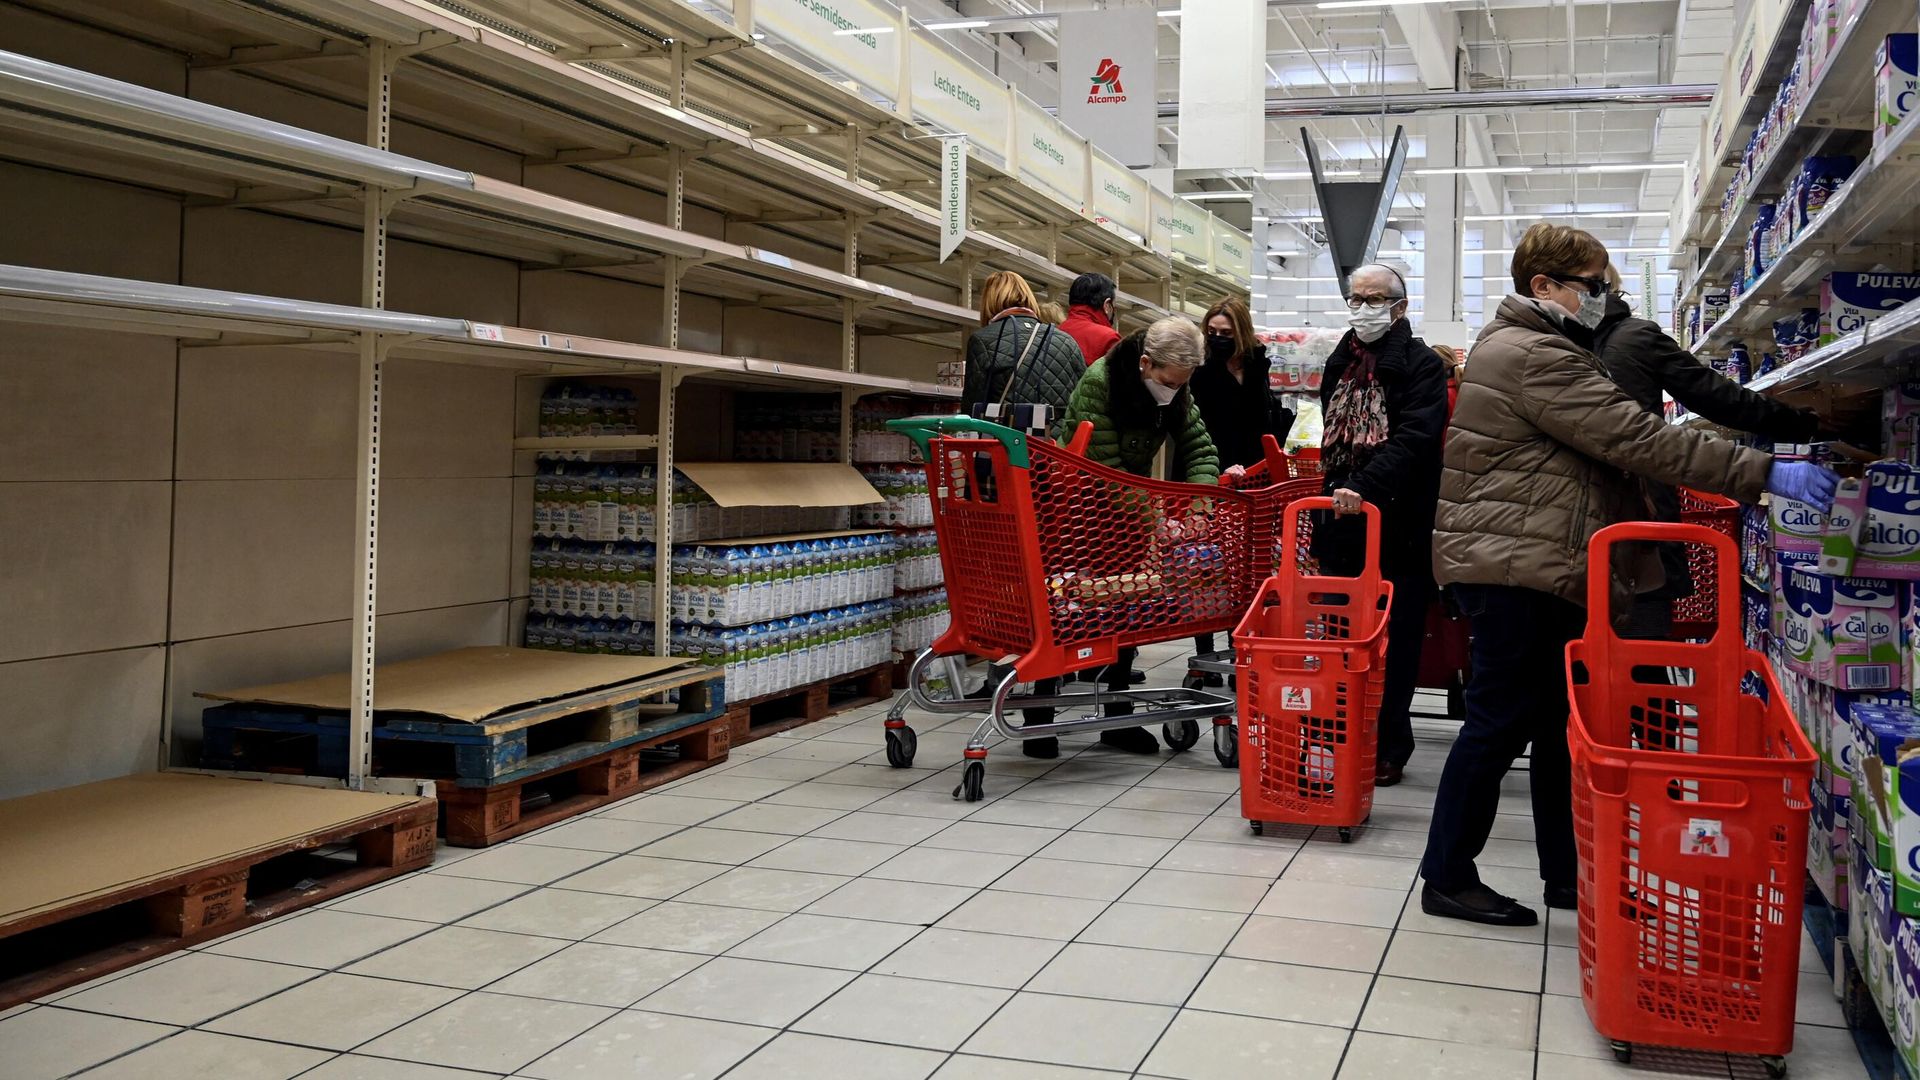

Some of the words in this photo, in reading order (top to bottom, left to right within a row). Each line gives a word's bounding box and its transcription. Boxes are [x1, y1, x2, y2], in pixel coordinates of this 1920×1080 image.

[934, 71, 956, 97] Leche
[957, 85, 980, 111] Entera
[1087, 96, 1127, 104] Alcampo
[1033, 132, 1048, 154] Leche
[1048, 144, 1064, 165] Entera
[948, 145, 959, 236] semidesnatada
[1645, 290, 1653, 320] speciales
[1872, 471, 1920, 494] PUL
[1781, 508, 1821, 525] Calc
[1868, 522, 1920, 545] alcio
[1790, 569, 1821, 594] PULEVA
[1842, 577, 1888, 589] PULEVA
[1785, 619, 1808, 644] Calcio
